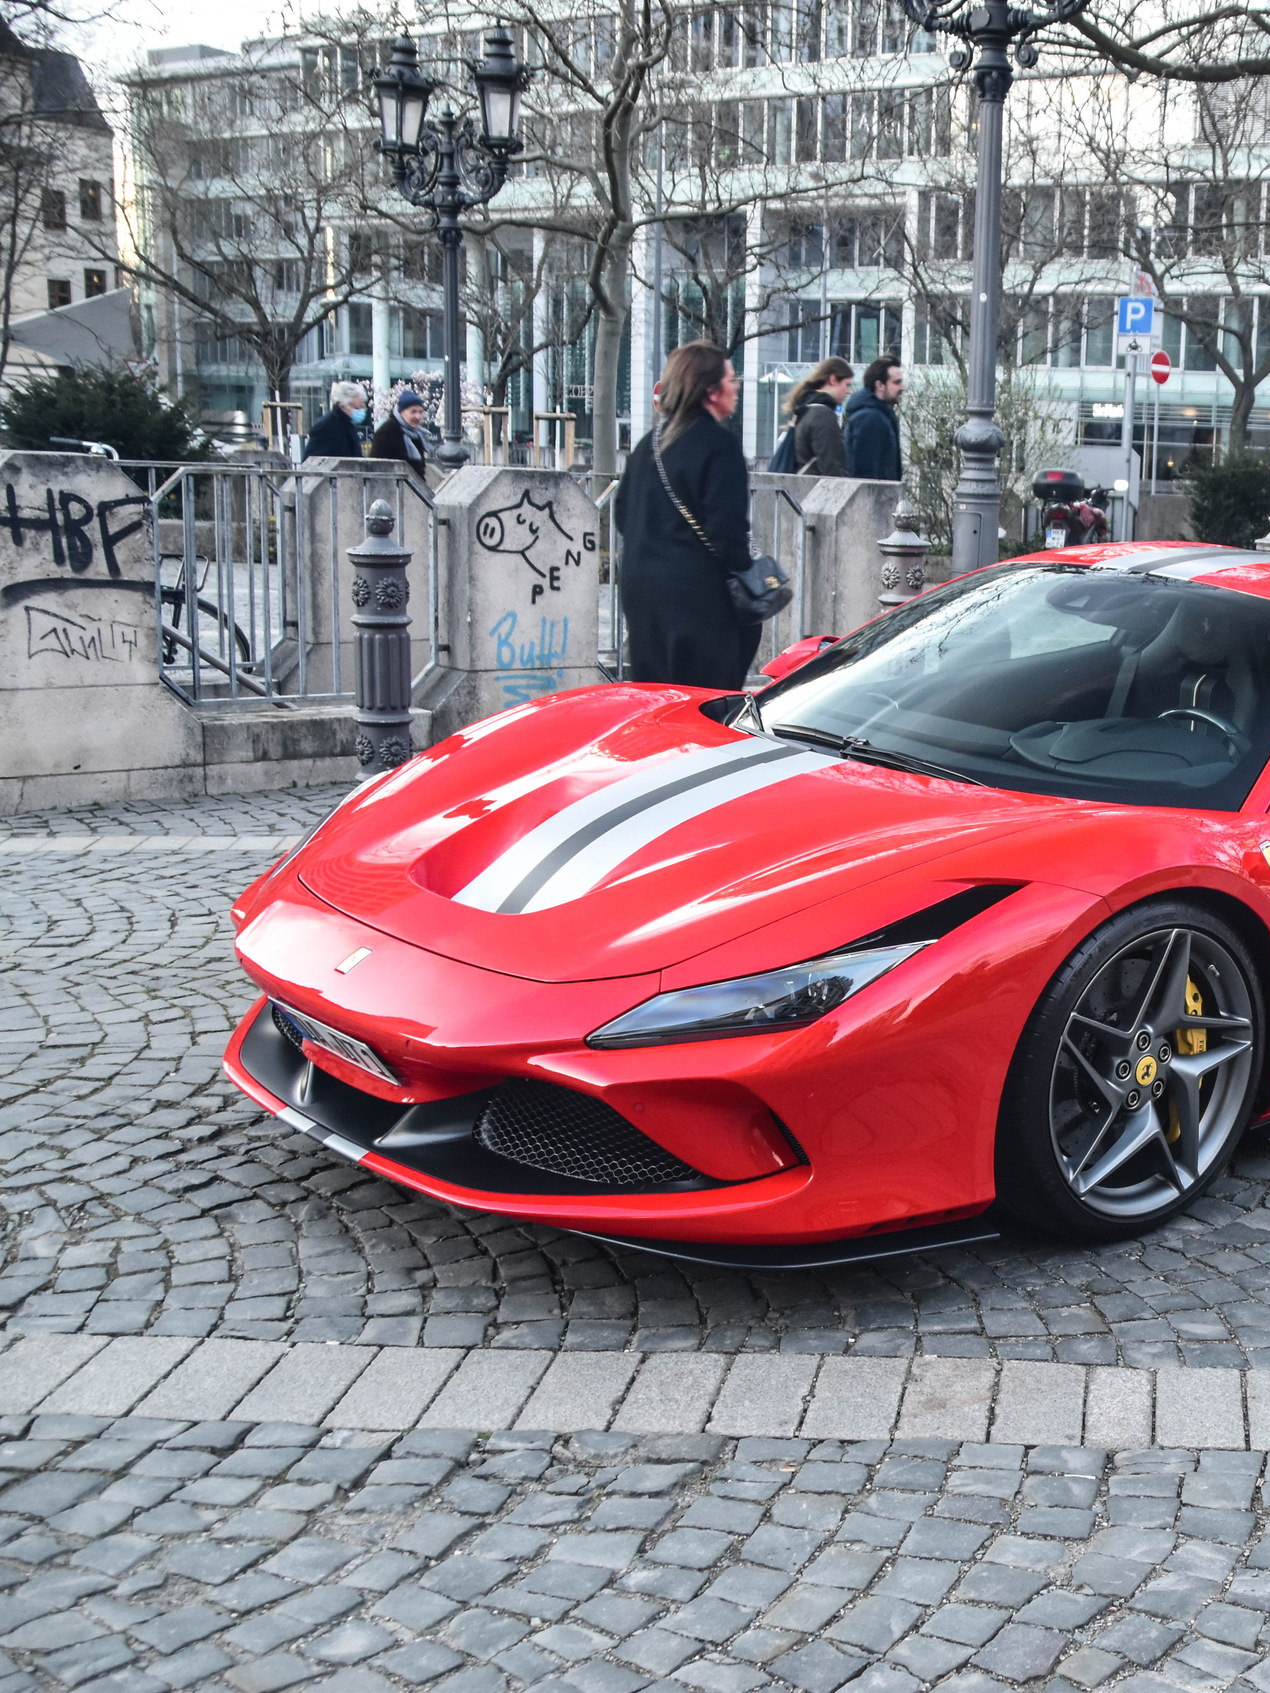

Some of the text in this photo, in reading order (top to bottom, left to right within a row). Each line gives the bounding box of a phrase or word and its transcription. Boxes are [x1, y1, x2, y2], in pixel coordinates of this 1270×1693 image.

[1125, 301, 1146, 330] P
[0, 483, 152, 579] HBF
[531, 532, 596, 604] PENG
